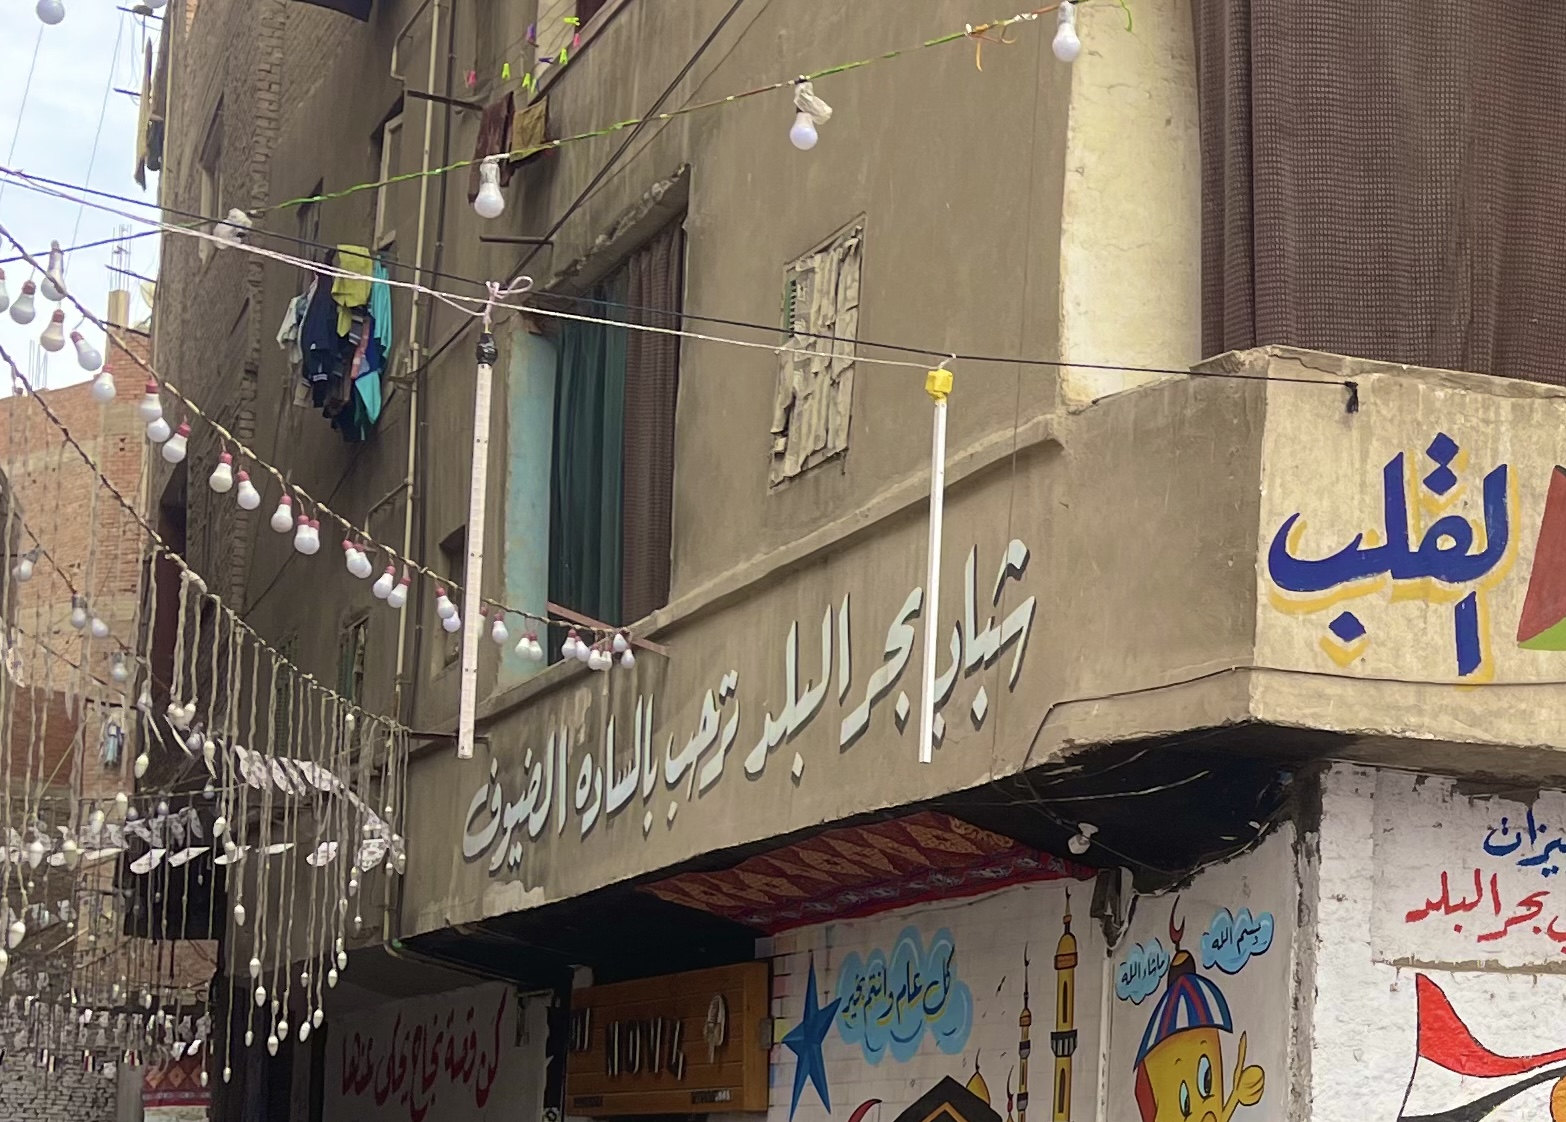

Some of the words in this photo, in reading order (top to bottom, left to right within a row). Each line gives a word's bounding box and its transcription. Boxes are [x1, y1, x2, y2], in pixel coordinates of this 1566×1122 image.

[1268, 432, 1509, 677] القلب
[840, 587, 923, 748] بحر
[931, 538, 1036, 741] شباب
[745, 592, 851, 780] البلد
[463, 722, 569, 872] الضيوف
[1405, 868, 1501, 933] البلد
[1477, 890, 1550, 943] بحر
[1121, 961, 1141, 986] الله
[1211, 926, 1233, 950] الله
[896, 960, 922, 1024] عام
[923, 944, 955, 1015] كل
